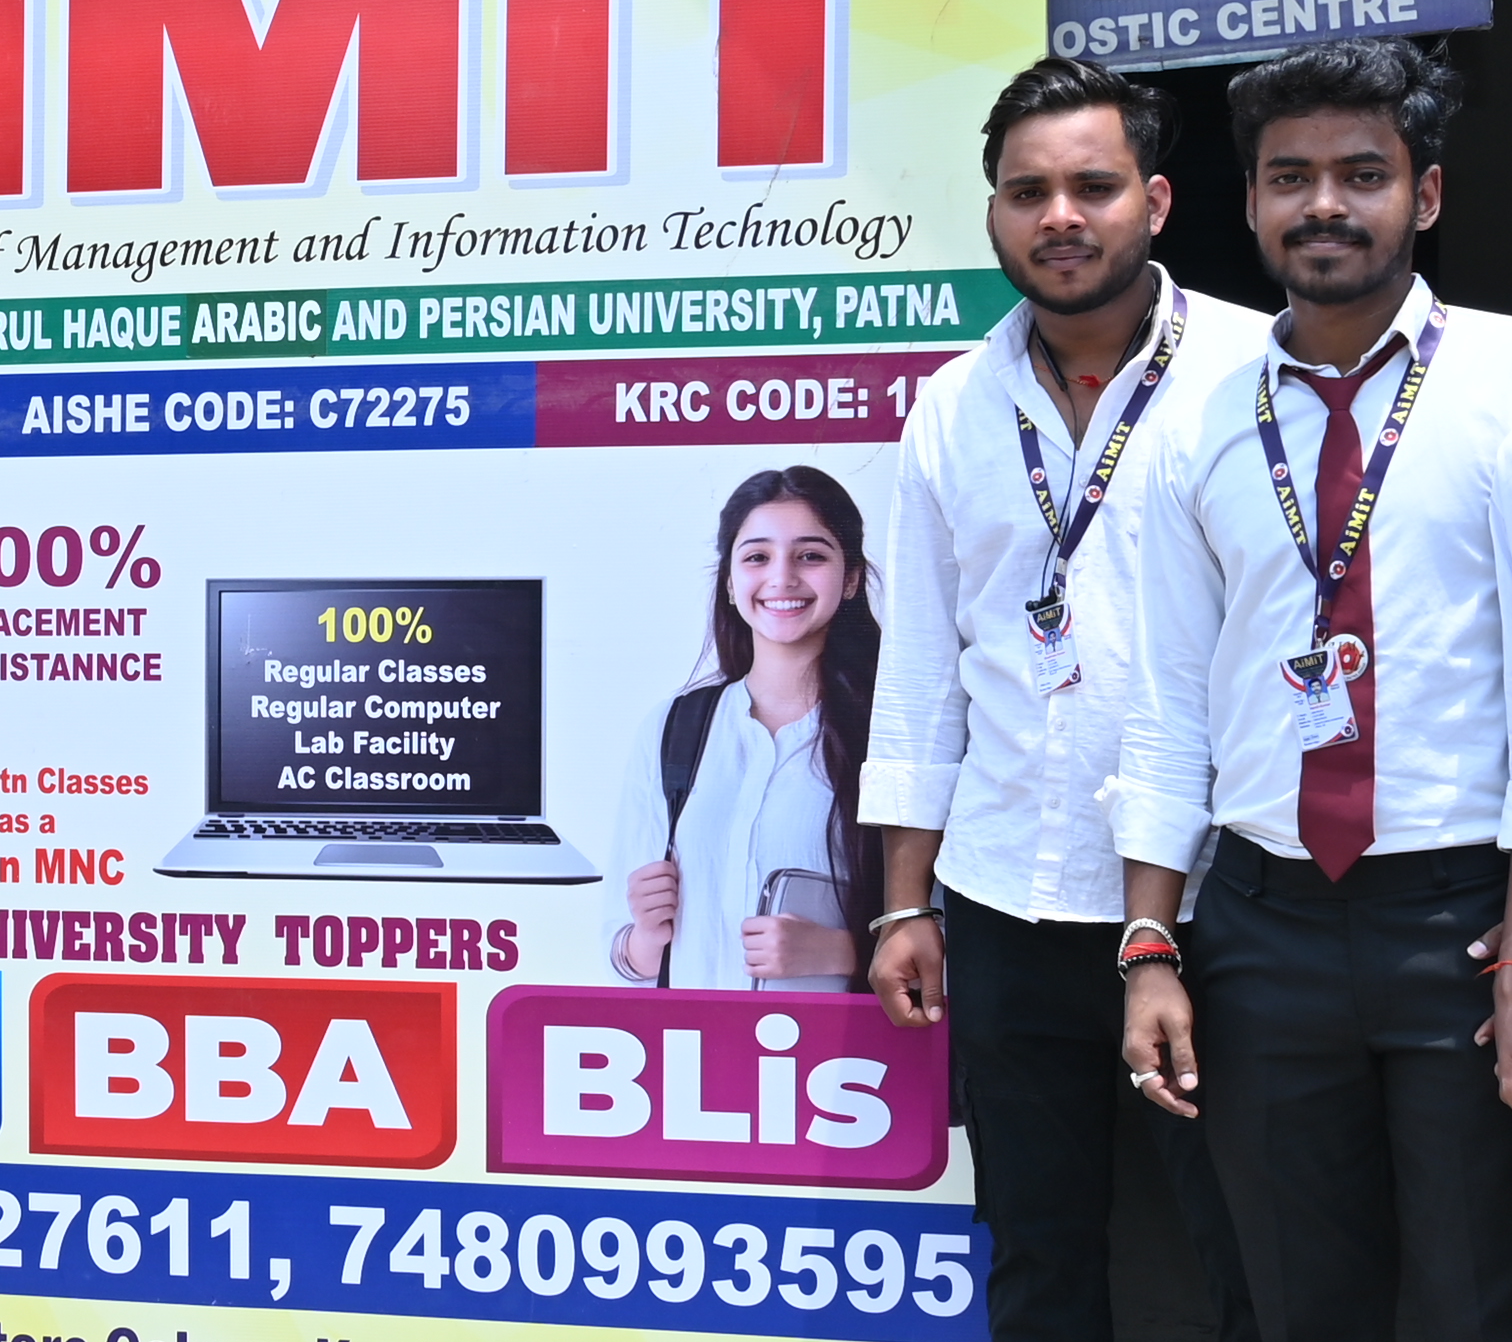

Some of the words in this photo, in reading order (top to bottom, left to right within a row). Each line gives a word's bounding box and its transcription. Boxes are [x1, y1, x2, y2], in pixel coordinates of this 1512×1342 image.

[13, 230, 280, 283] Management
[293, 215, 382, 265] and
[383, 211, 648, 274] Information
[661, 198, 914, 260] Technology
[62, 303, 182, 349] HAQUE
[191, 299, 323, 345] ARABIC
[332, 296, 408, 342] AND
[418, 293, 577, 339] PERSIAN
[587, 285, 824, 340] UNIVERSITY,
[835, 281, 961, 329] PATNA
[21, 392, 151, 435] AISHE
[163, 388, 296, 434] CODE:
[308, 384, 472, 430] C72275
[614, 380, 712, 424] KRC
[726, 376, 871, 421] CODE:
[1390, 361, 1428, 425] AiMiT
[1095, 420, 1132, 483] AiMiT
[1276, 485, 1307, 547] AiMiT
[1339, 487, 1377, 557] AiMiT
[316, 605, 434, 645] 100%
[264, 658, 370, 690] Regular
[377, 659, 488, 684] Classes
[251, 695, 357, 725] Regular
[364, 695, 502, 725] Computer
[294, 731, 345, 755] Lab
[353, 730, 456, 762] Facility
[37, 767, 150, 797] Classes
[277, 765, 317, 791] AC
[324, 766, 472, 792] Classroom
[38, 813, 57, 836] a
[34, 847, 126, 886] MNC
[275, 914, 520, 972] TOPPERS
[73, 1010, 413, 1131] BBA
[542, 1012, 894, 1150] BLis
[328, 1205, 975, 1319] 7480993595
